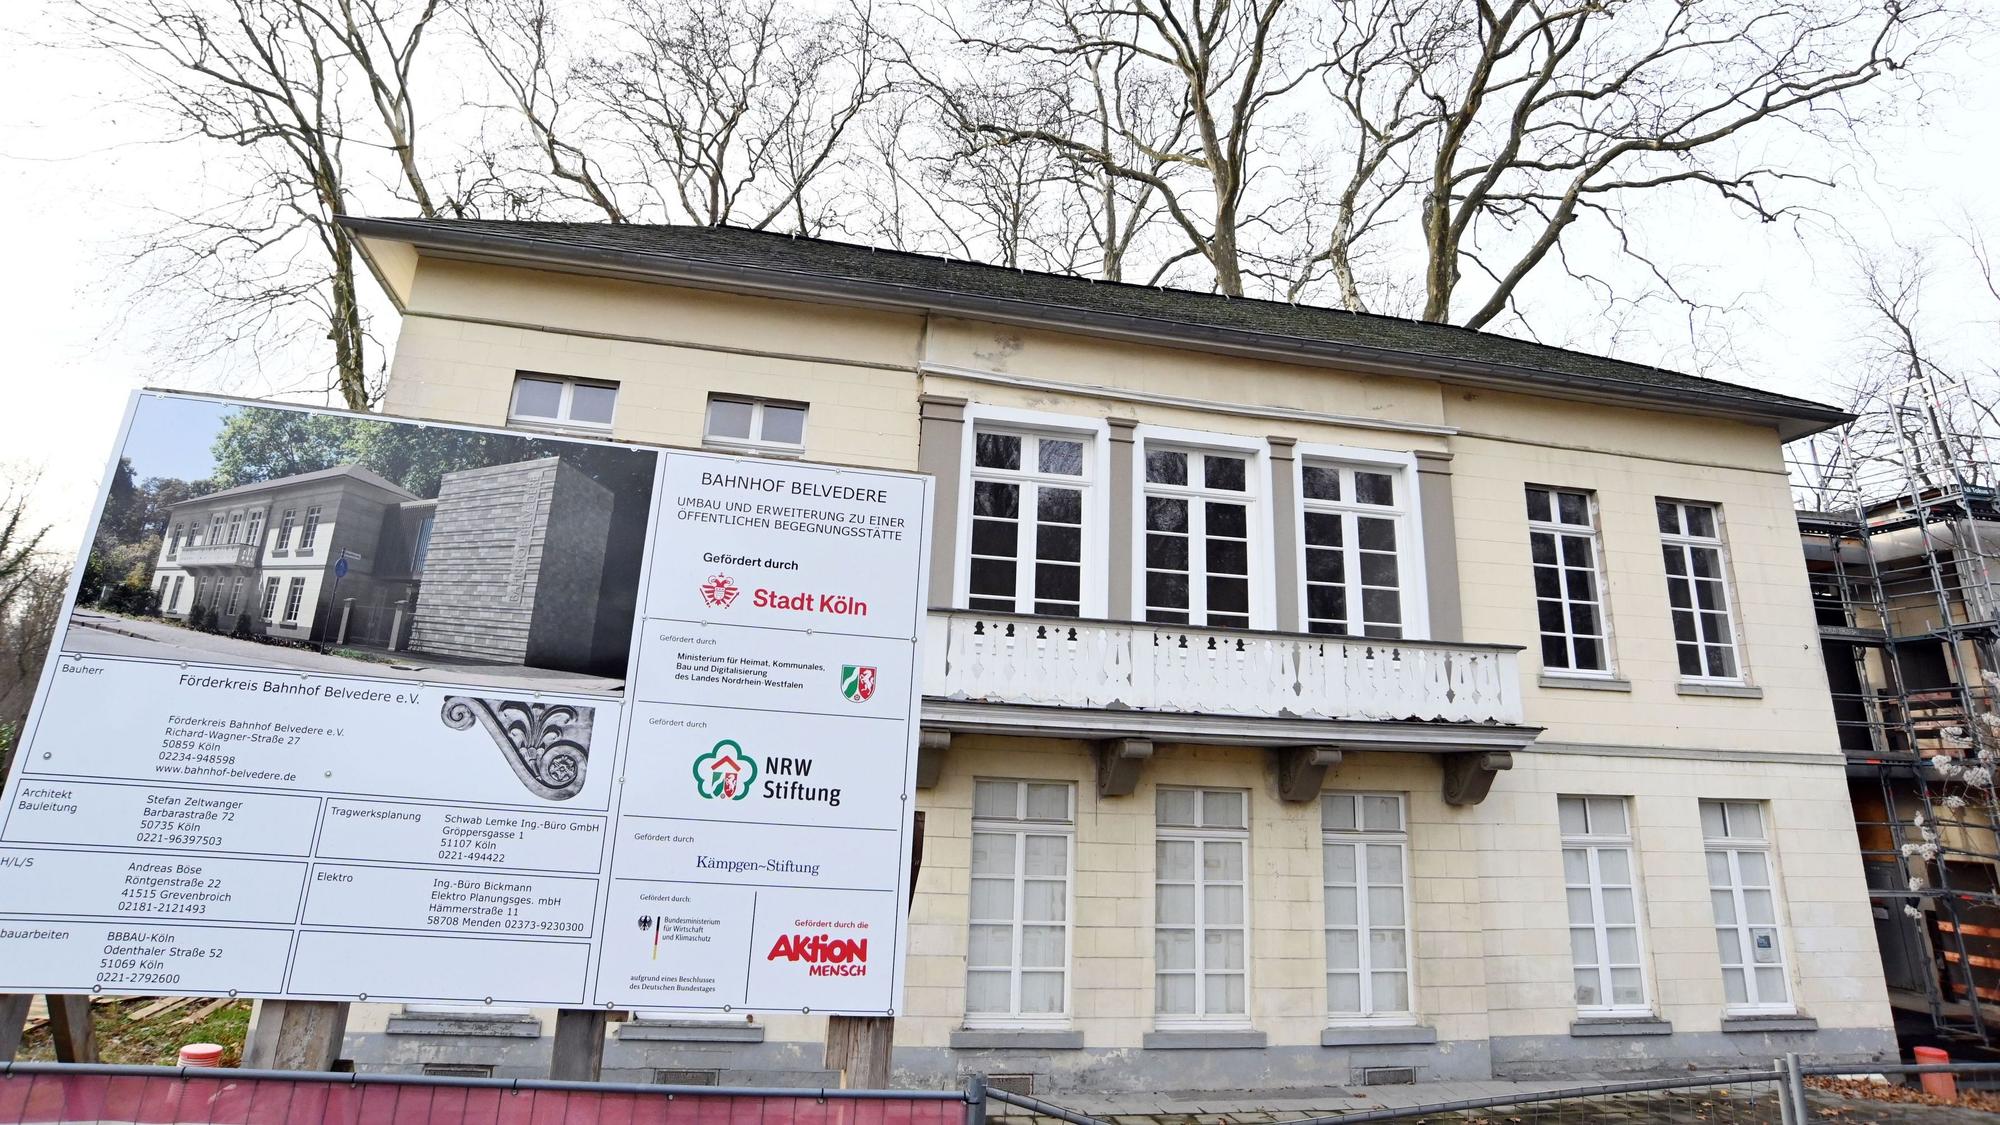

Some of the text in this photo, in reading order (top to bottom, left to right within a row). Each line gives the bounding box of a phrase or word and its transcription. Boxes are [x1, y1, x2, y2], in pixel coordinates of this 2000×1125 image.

[701, 472, 887, 503] BAHNHOF BELVEDERE
[677, 497, 904, 529] UMBAU UND ERWEITERUNG ZU EINER
[677, 510, 902, 541] ÖFFENTLICHEN BEGEGNUNGSSTÄTTE
[703, 552, 798, 570] Gefördert durch
[753, 589, 867, 616] Stadt Köln
[659, 635, 694, 643] Gefördert
[677, 652, 725, 663] Ministerium
[62, 664, 104, 675] Bauherr
[676, 662, 692, 670] Bau
[711, 665, 768, 678] Digitalisierung
[691, 674, 720, 683] Landes
[721, 676, 803, 689] Nordrhein-Westfalen
[179, 674, 419, 704] Förderkreis Bahnhof Belvedere e.V.
[168, 715, 344, 736] Förderkreis Bahnhof Belvedere e.V.
[649, 718, 684, 727] Gefördert
[165, 727, 301, 745] Richard-Wagner-Straße 27
[162, 739, 221, 751] 50859 Köln
[159, 751, 235, 765] 02234-948598
[766, 756, 812, 776] NRW
[156, 765, 296, 781] www.bahnhof-belvedere.de
[22, 788, 72, 799] Architekt
[146, 795, 181, 805] Stefan
[763, 780, 841, 807] Stiftung
[18, 800, 77, 814] Bauleitung
[143, 807, 235, 821] Barbarastraße 72
[331, 806, 421, 823] Tragwerksplanung
[140, 820, 200, 832] 50735 Köln
[445, 814, 599, 832] Schwab Lemke Ing.-Büro GmbH
[136, 832, 222, 846] 0221-96397503
[442, 826, 523, 839] Gröppersgasse 1
[634, 833, 670, 842] Gefördert
[440, 838, 496, 850] 51107 Köln
[0, 857, 34, 868] H/L/S
[438, 850, 505, 863] 0221-494422
[128, 862, 202, 874] Andreas Böse
[125, 875, 221, 888] Röntgenstraße 22
[317, 872, 353, 882] Elektro
[433, 878, 532, 892] Ing.-Büro Bickmann
[121, 888, 231, 902] 41515 Grevenbroich
[431, 891, 561, 906] Elektro Planungsges. mbH
[118, 901, 206, 914] 02181-2121493
[429, 903, 518, 916] Hämmerstraße 11
[427, 915, 584, 932] 58708 Menden 02373-9230300
[664, 916, 721, 925] Bundesministerium
[795, 919, 869, 929] Gefördert durch die
[663, 924, 704, 933] für Wirtschaft
[107, 931, 175, 943] BBBAU-Köln
[675, 934, 711, 942] Klimaschutz
[104, 945, 223, 958] Odenthaler Straße 52
[100, 958, 164, 969] 51069 Köln
[809, 965, 866, 977] MENSCH
[96, 972, 180, 984] 0221-2792600
[641, 983, 675, 991] Deutschen
[676, 984, 716, 993] Bundestages
